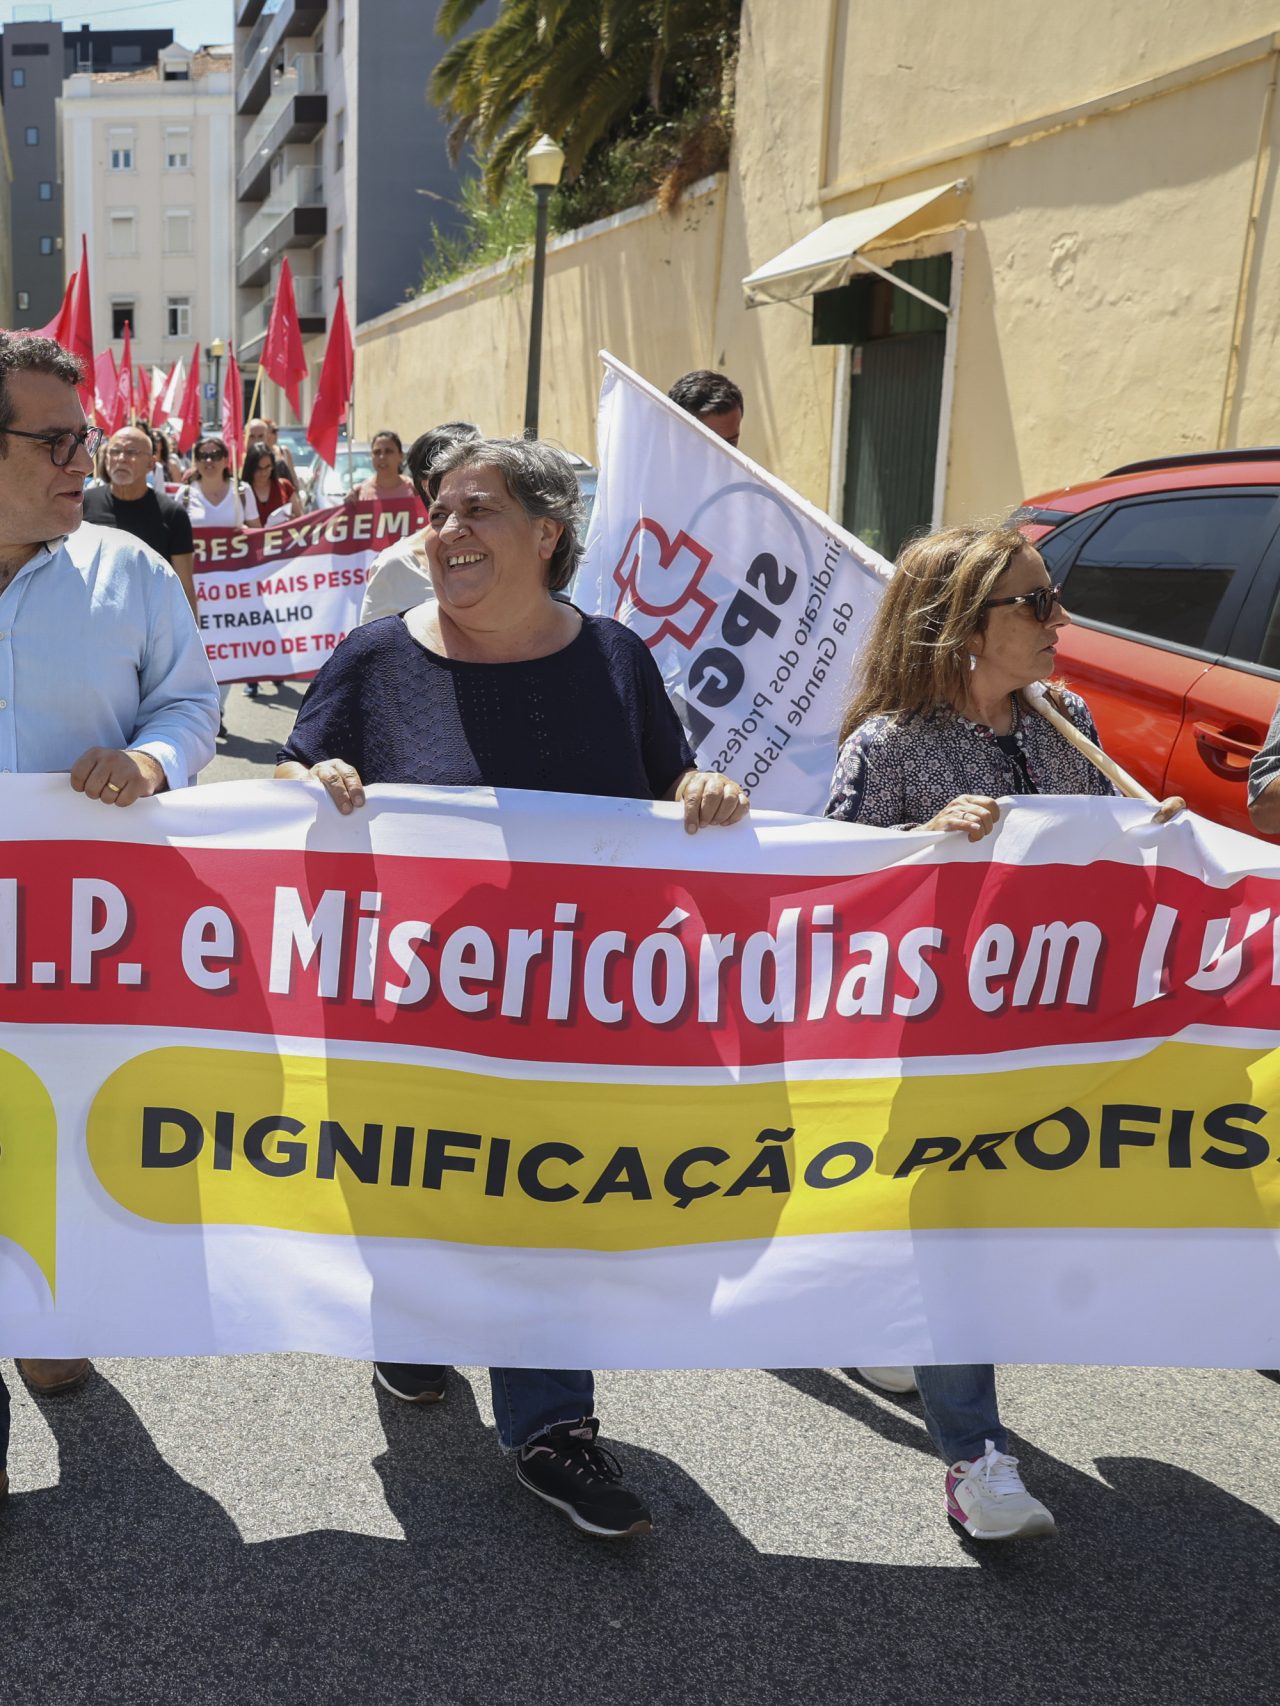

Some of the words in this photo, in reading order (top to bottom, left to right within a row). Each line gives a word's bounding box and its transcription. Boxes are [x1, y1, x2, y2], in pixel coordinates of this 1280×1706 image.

[206, 384, 216, 398] P
[225, 583, 251, 600] DE
[256, 575, 308, 597] MAIS
[213, 604, 313, 629] TRABALHO
[281, 636, 308, 654] DE
[180, 906, 235, 990] e
[268, 885, 943, 1025] Misericórdias
[966, 920, 1103, 1013] em
[141, 1105, 874, 1209] DIGNIFICAÇÃO
[892, 1103, 1280, 1180] PROFIS
